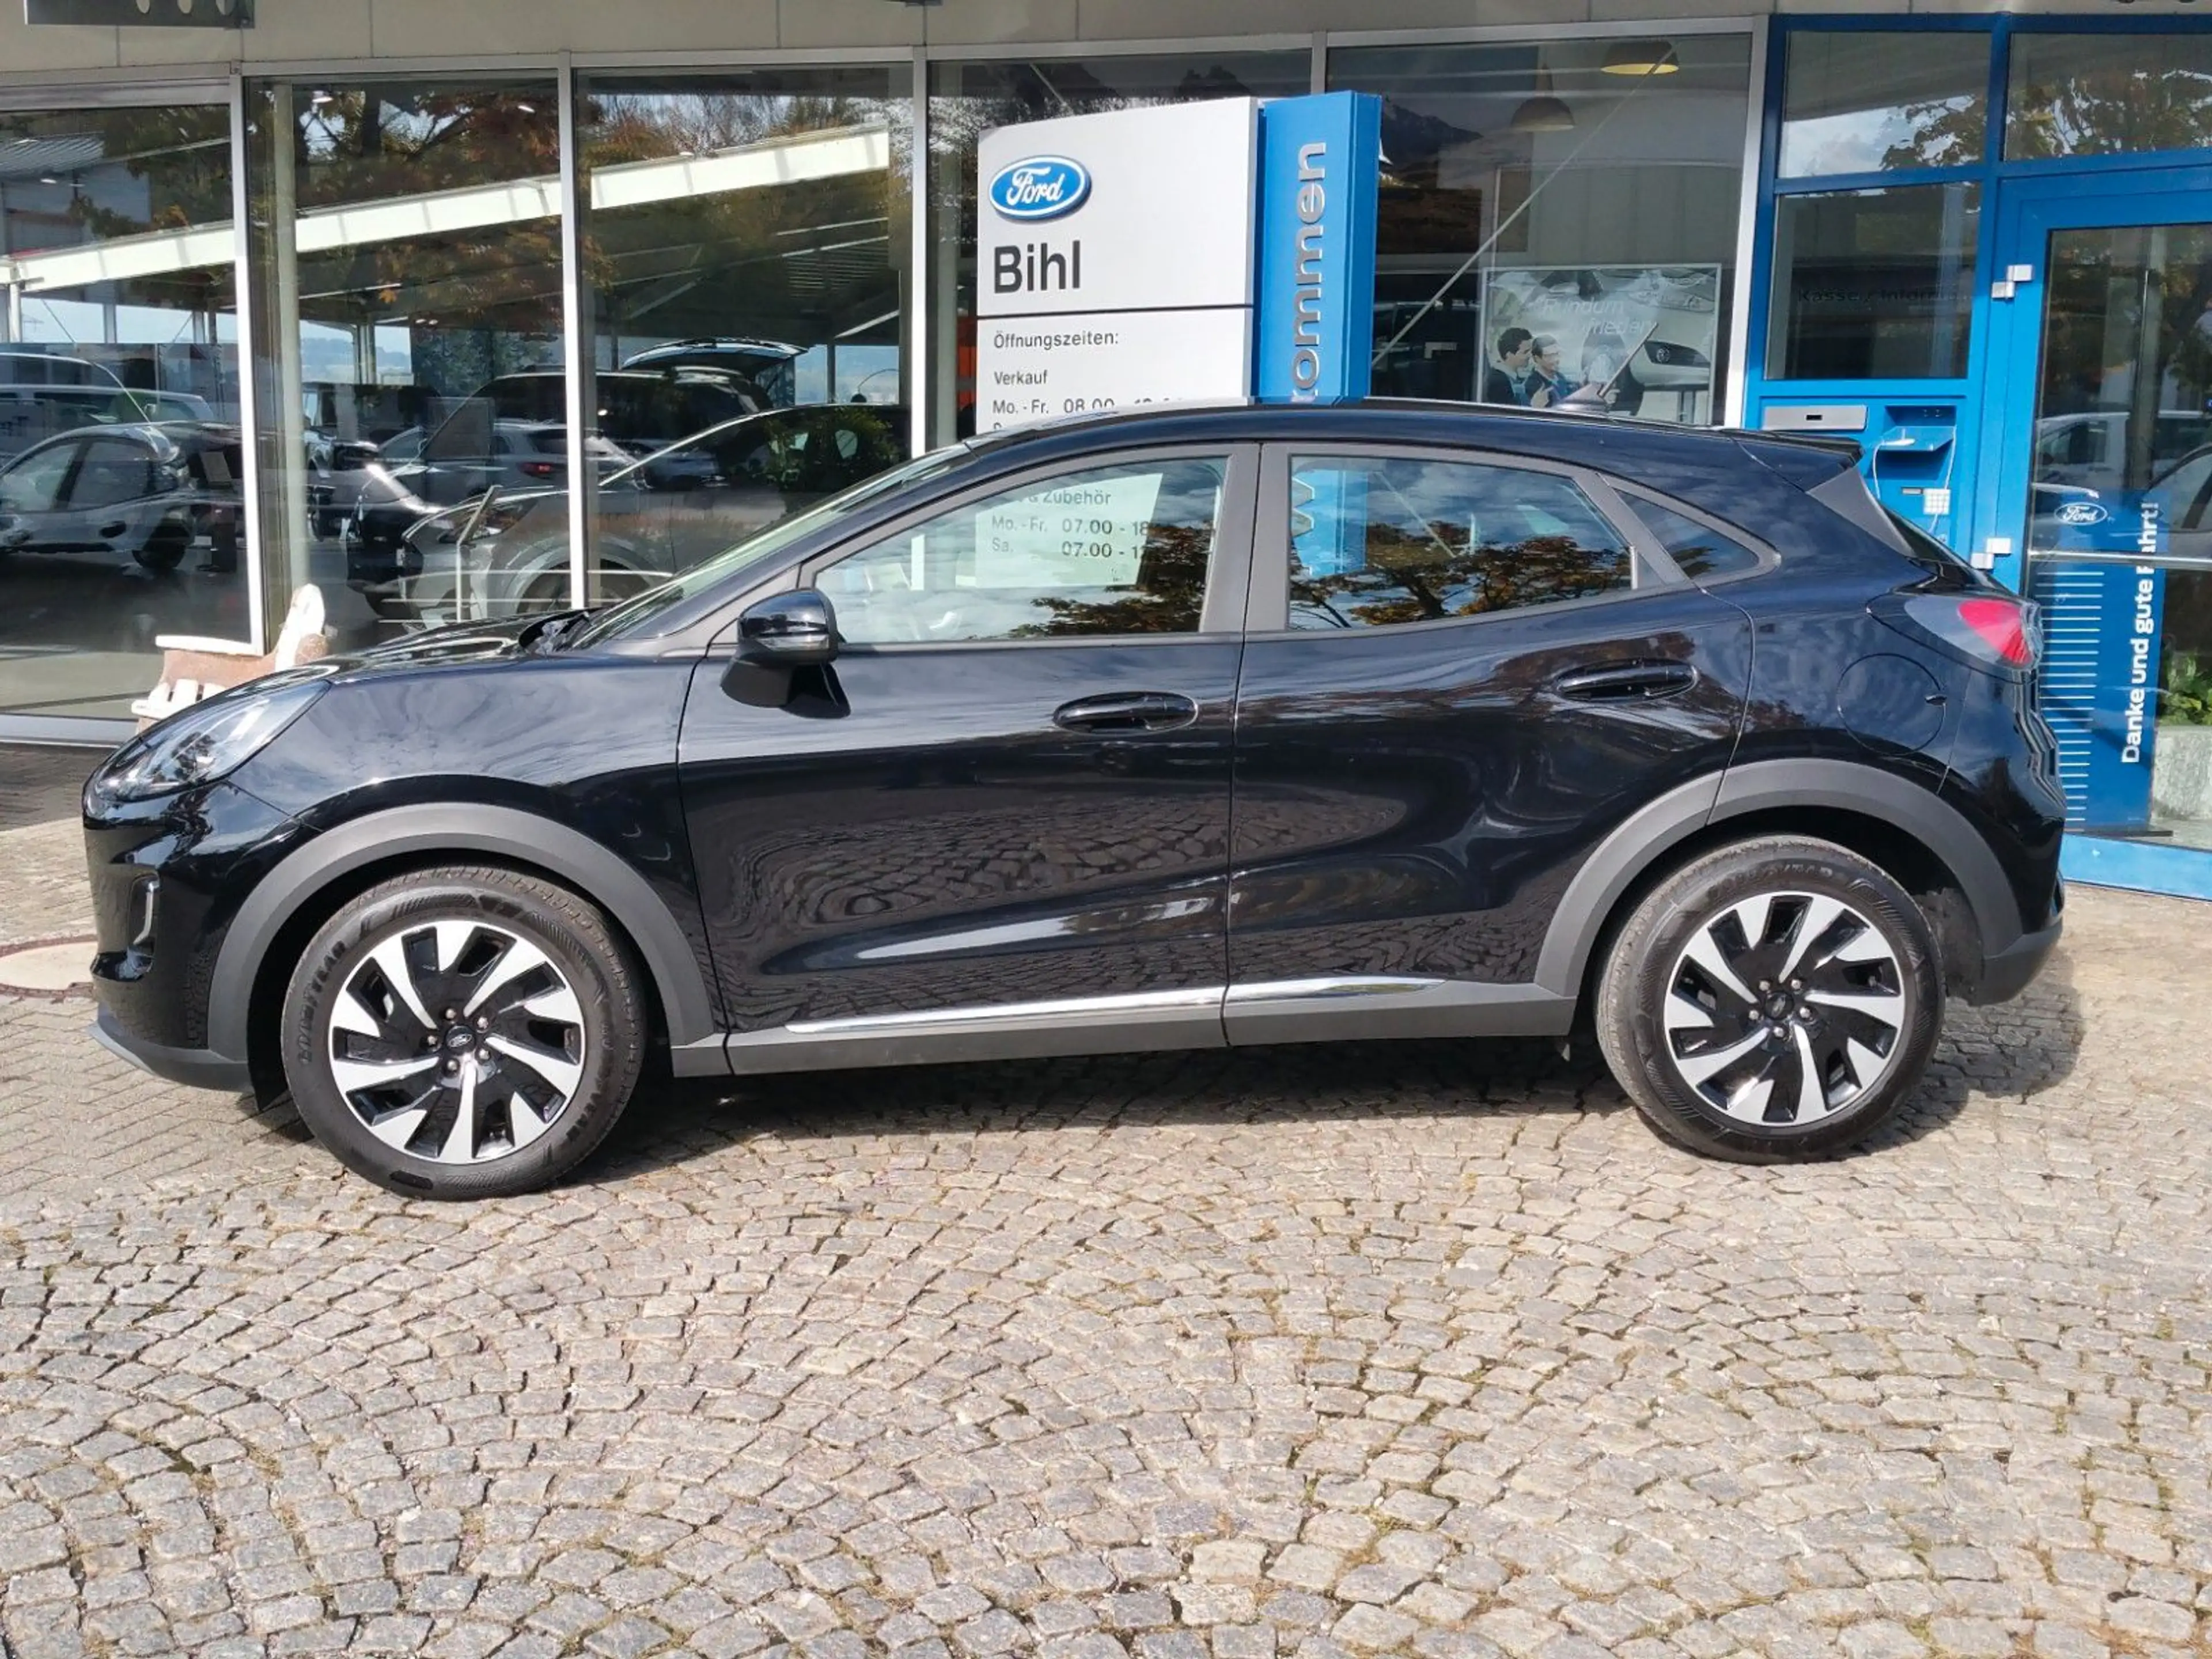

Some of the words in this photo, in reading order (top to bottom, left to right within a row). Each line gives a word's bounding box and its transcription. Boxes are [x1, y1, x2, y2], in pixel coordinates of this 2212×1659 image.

[1006, 166, 1066, 206] Ford
[994, 240, 1081, 294] Bihl
[993, 330, 1119, 351] Öffnungszeiten:
[993, 370, 1048, 386] Verkauf
[1043, 490, 1112, 505] Zubehör
[2062, 506, 2099, 524] Ford
[1062, 519, 1113, 535] 07.00
[991, 537, 1014, 552] Sa.
[1061, 540, 1112, 558] 07.00
[2134, 578, 2155, 634] gute
[2130, 638, 2150, 684] und
[2121, 688, 2146, 763] Danke
